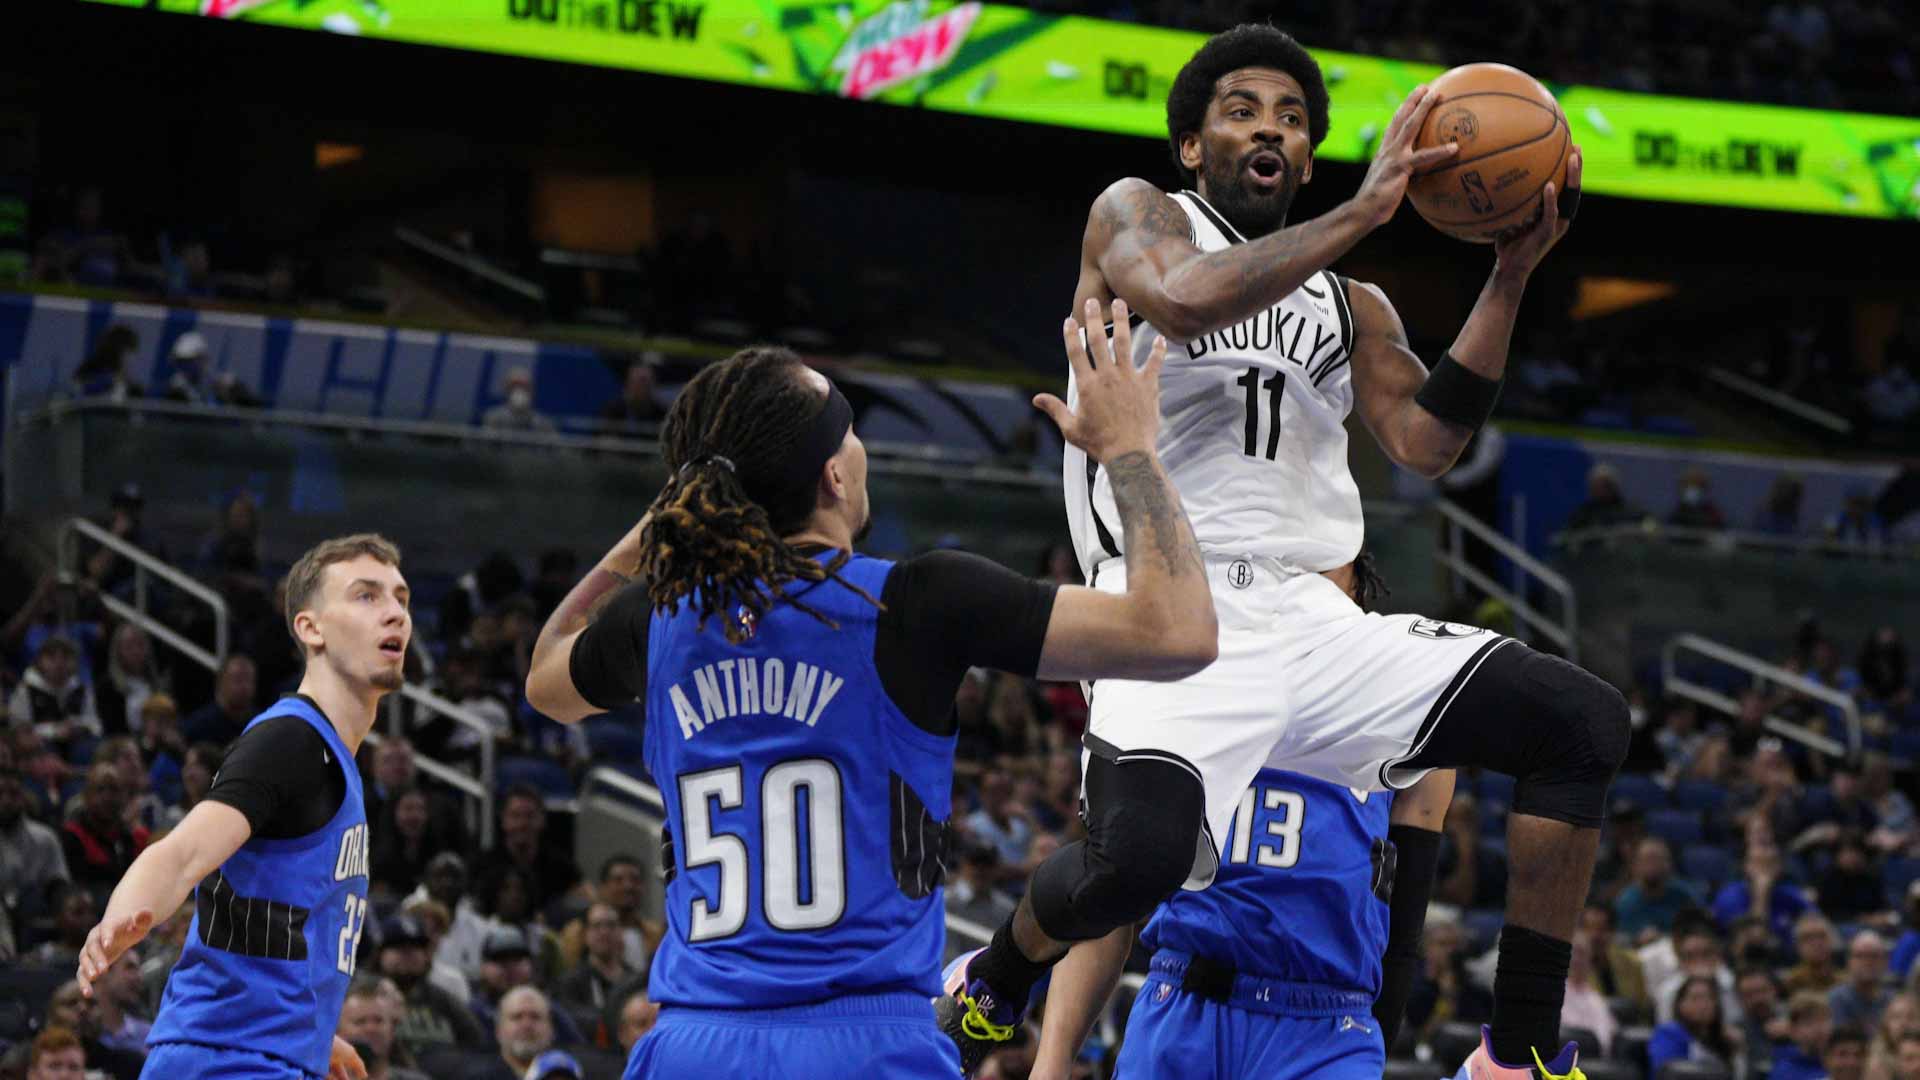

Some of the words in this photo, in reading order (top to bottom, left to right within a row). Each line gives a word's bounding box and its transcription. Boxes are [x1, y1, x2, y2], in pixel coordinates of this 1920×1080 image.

[619, 0, 703, 39] DEW
[1104, 61, 1148, 99] DO
[1634, 132, 1678, 166] DO
[1727, 138, 1801, 176] DEW
[1237, 367, 1285, 461] 11
[668, 658, 844, 740] ANTHONY
[677, 758, 846, 945] 50
[1230, 786, 1306, 868] 13
[336, 893, 367, 977] 22
